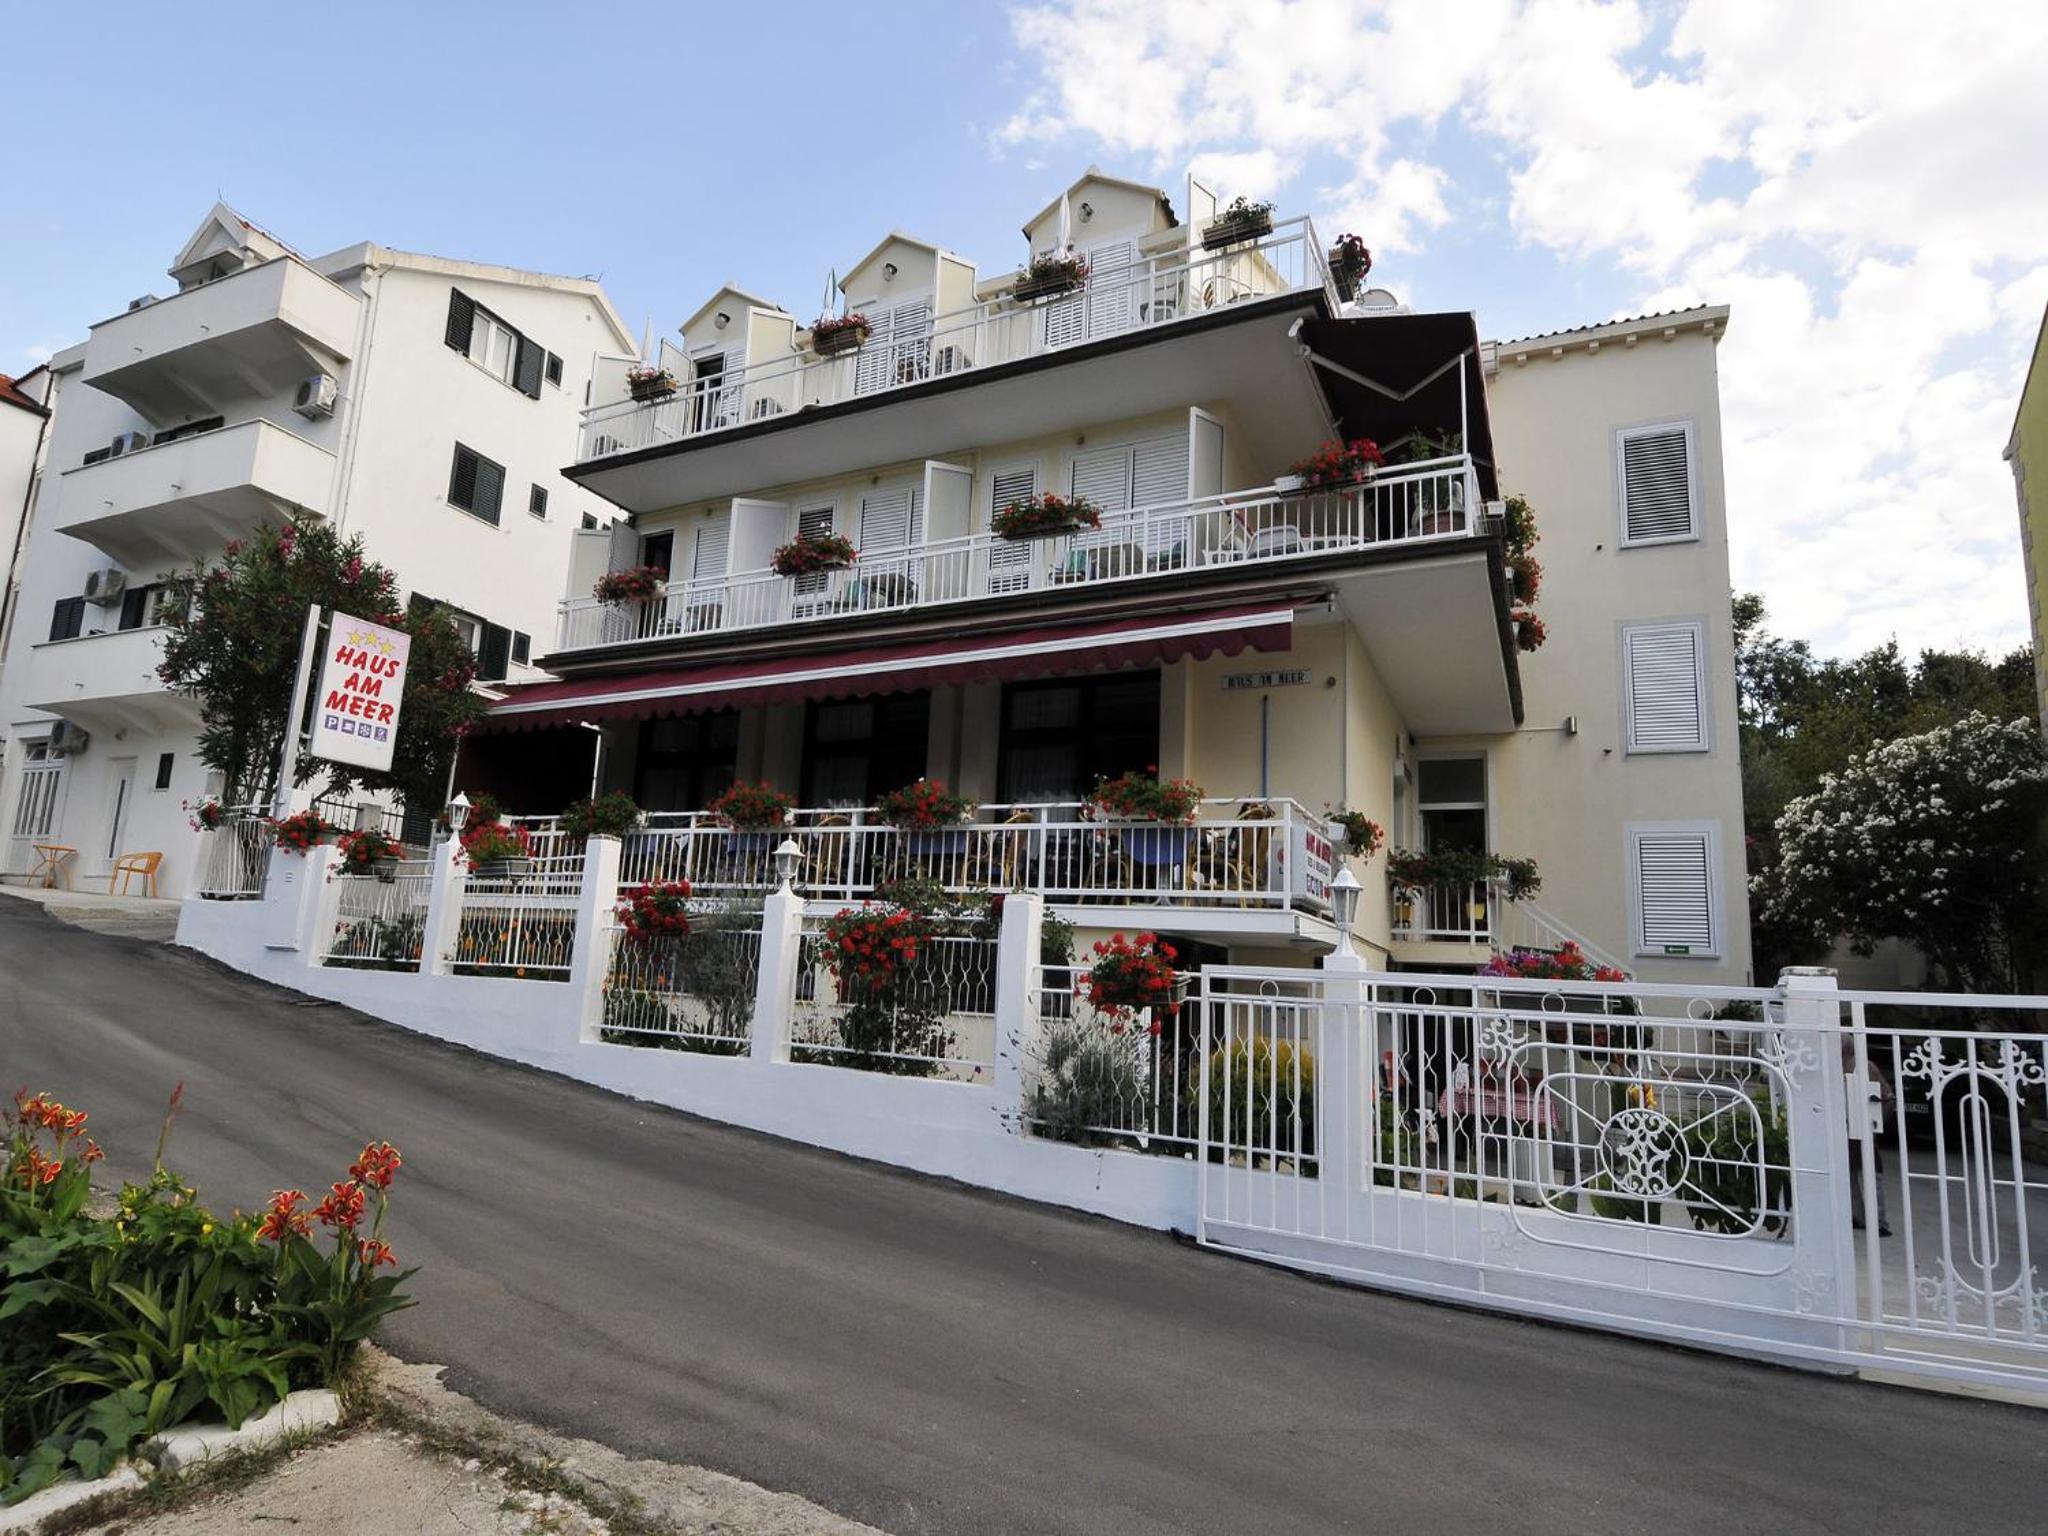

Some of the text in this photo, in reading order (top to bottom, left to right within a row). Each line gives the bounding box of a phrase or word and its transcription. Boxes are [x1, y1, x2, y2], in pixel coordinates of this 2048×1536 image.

[335, 645, 400, 678] HAUS
[344, 672, 383, 697] AM
[325, 690, 394, 725] MEER
